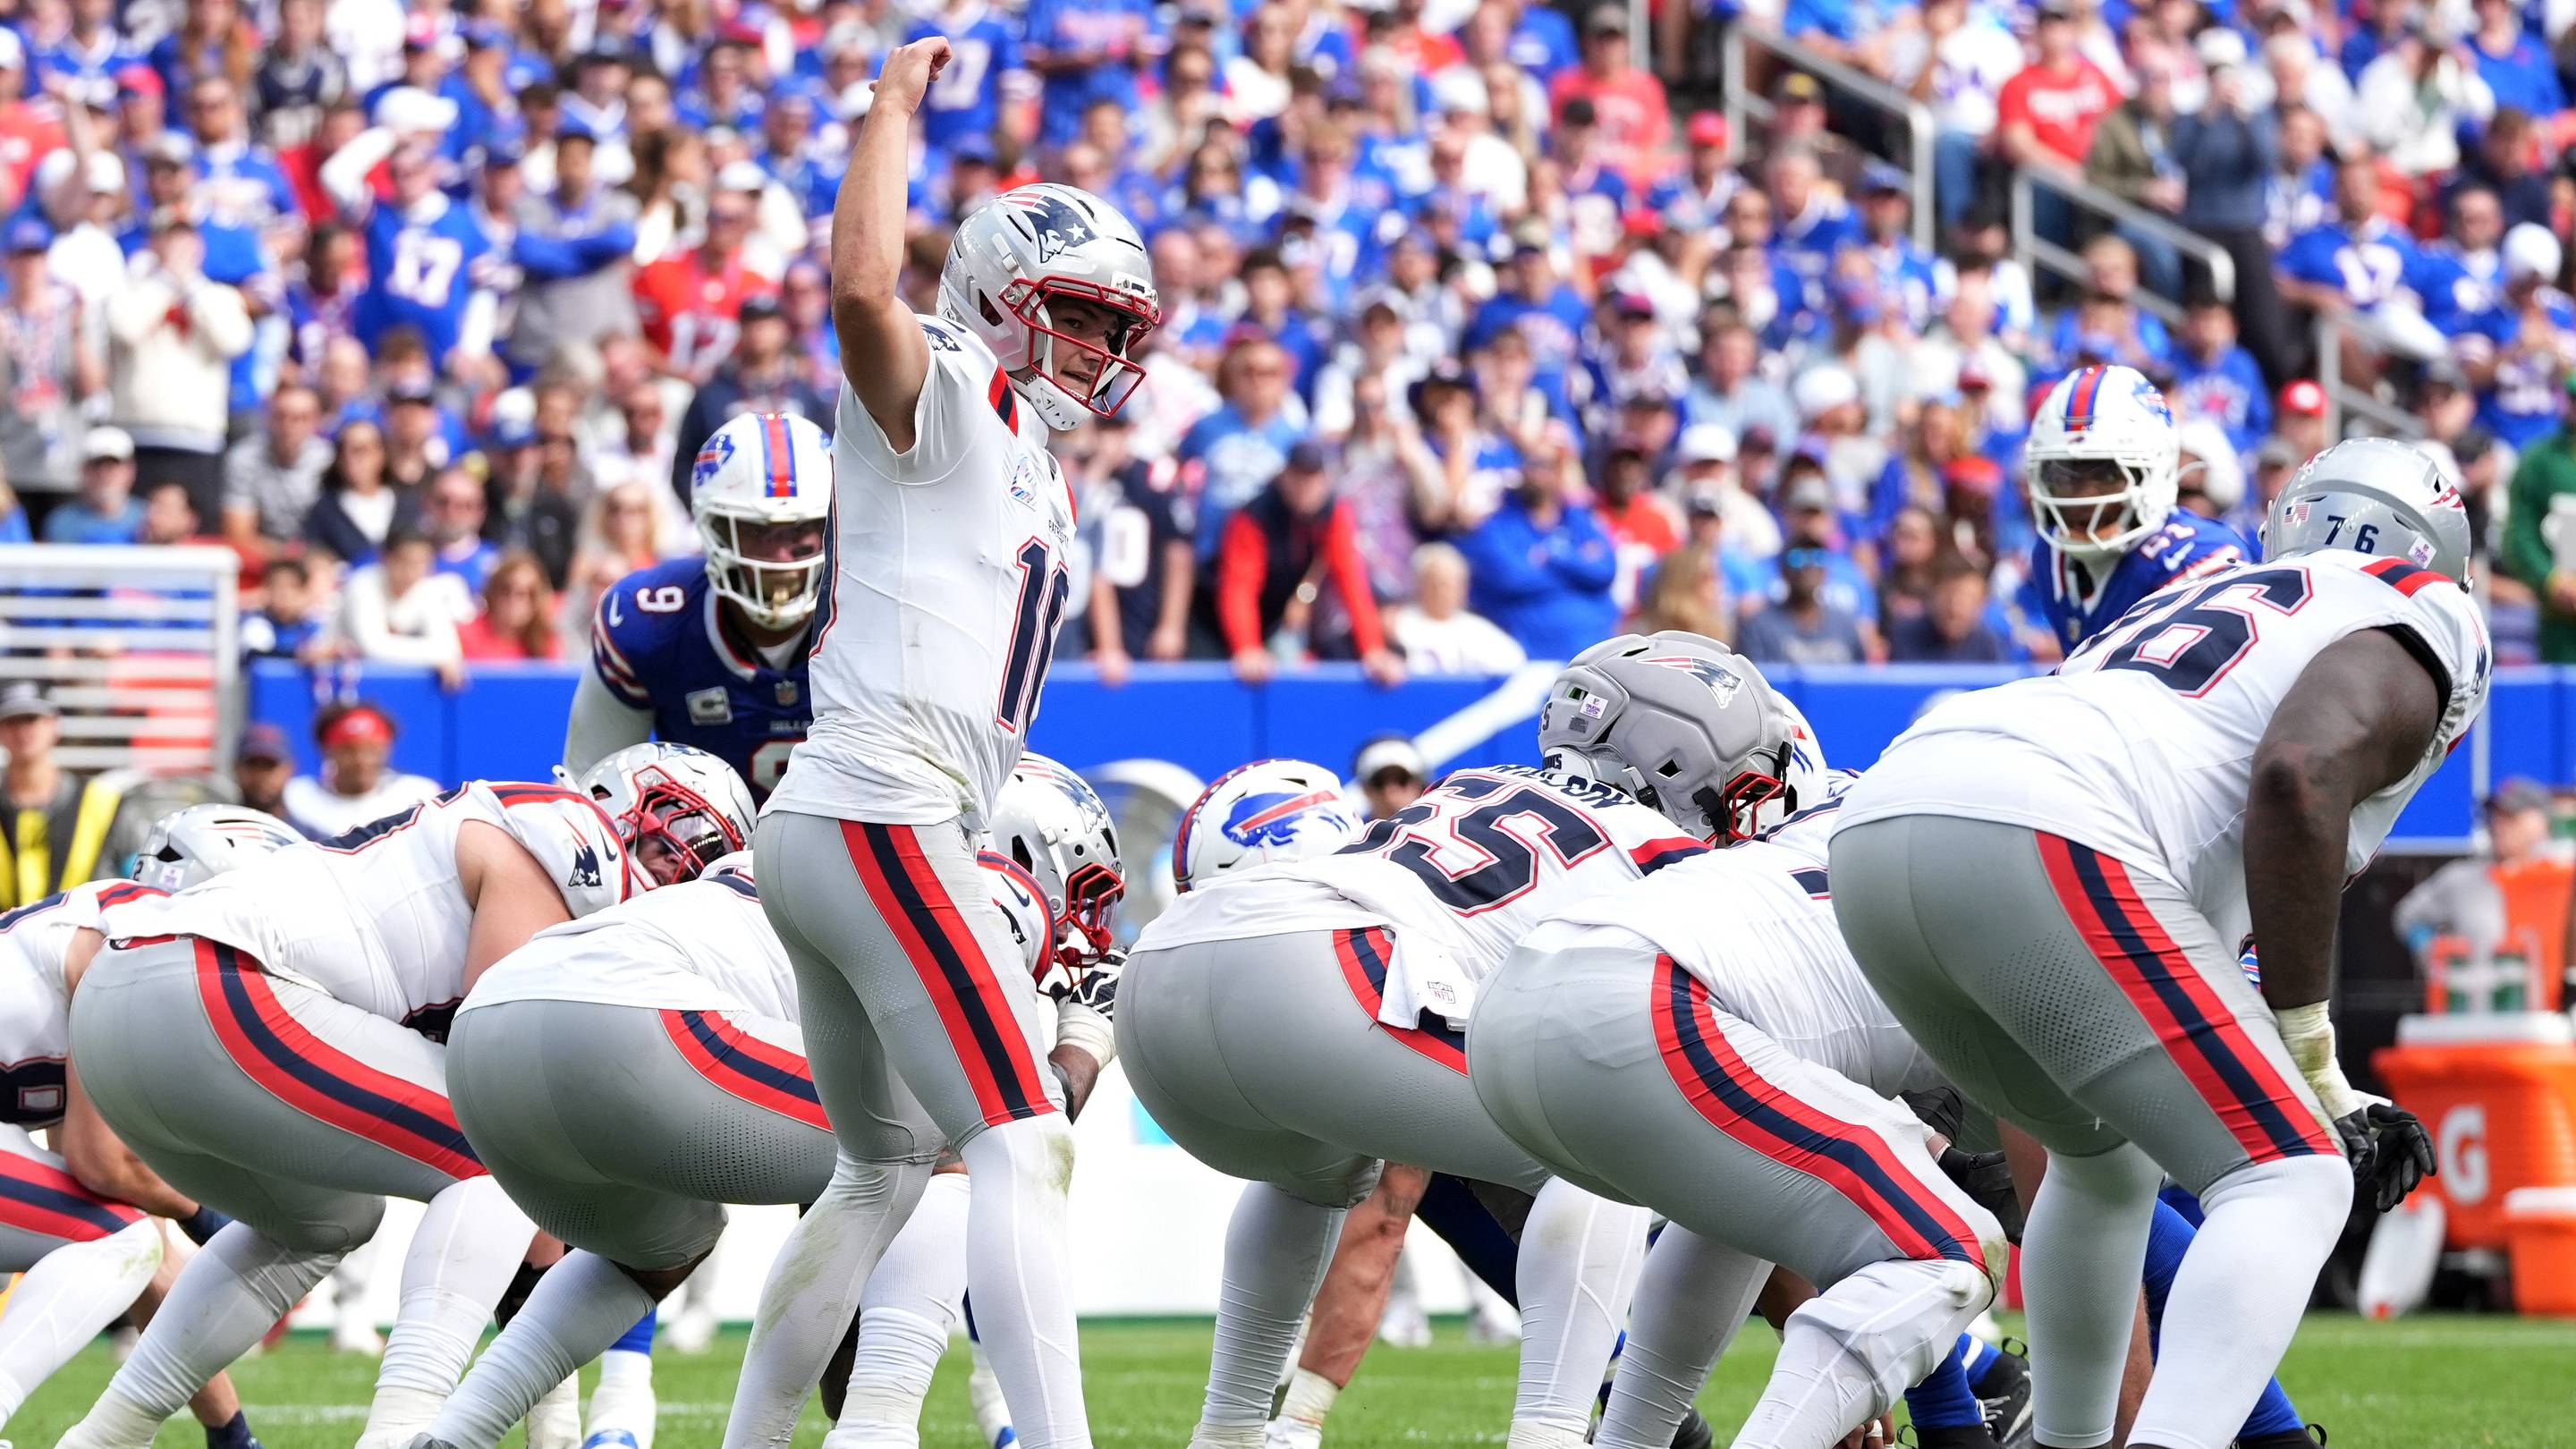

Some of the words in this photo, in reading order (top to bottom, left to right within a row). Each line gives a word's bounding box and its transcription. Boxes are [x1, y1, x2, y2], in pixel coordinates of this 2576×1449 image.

[2325, 515, 2379, 554] 76
[636, 586, 685, 613] 9
[2043, 565, 2314, 699] 76
[691, 691, 725, 715] C
[1489, 764, 1636, 809] WILSON
[2438, 1104, 2490, 1205] G
